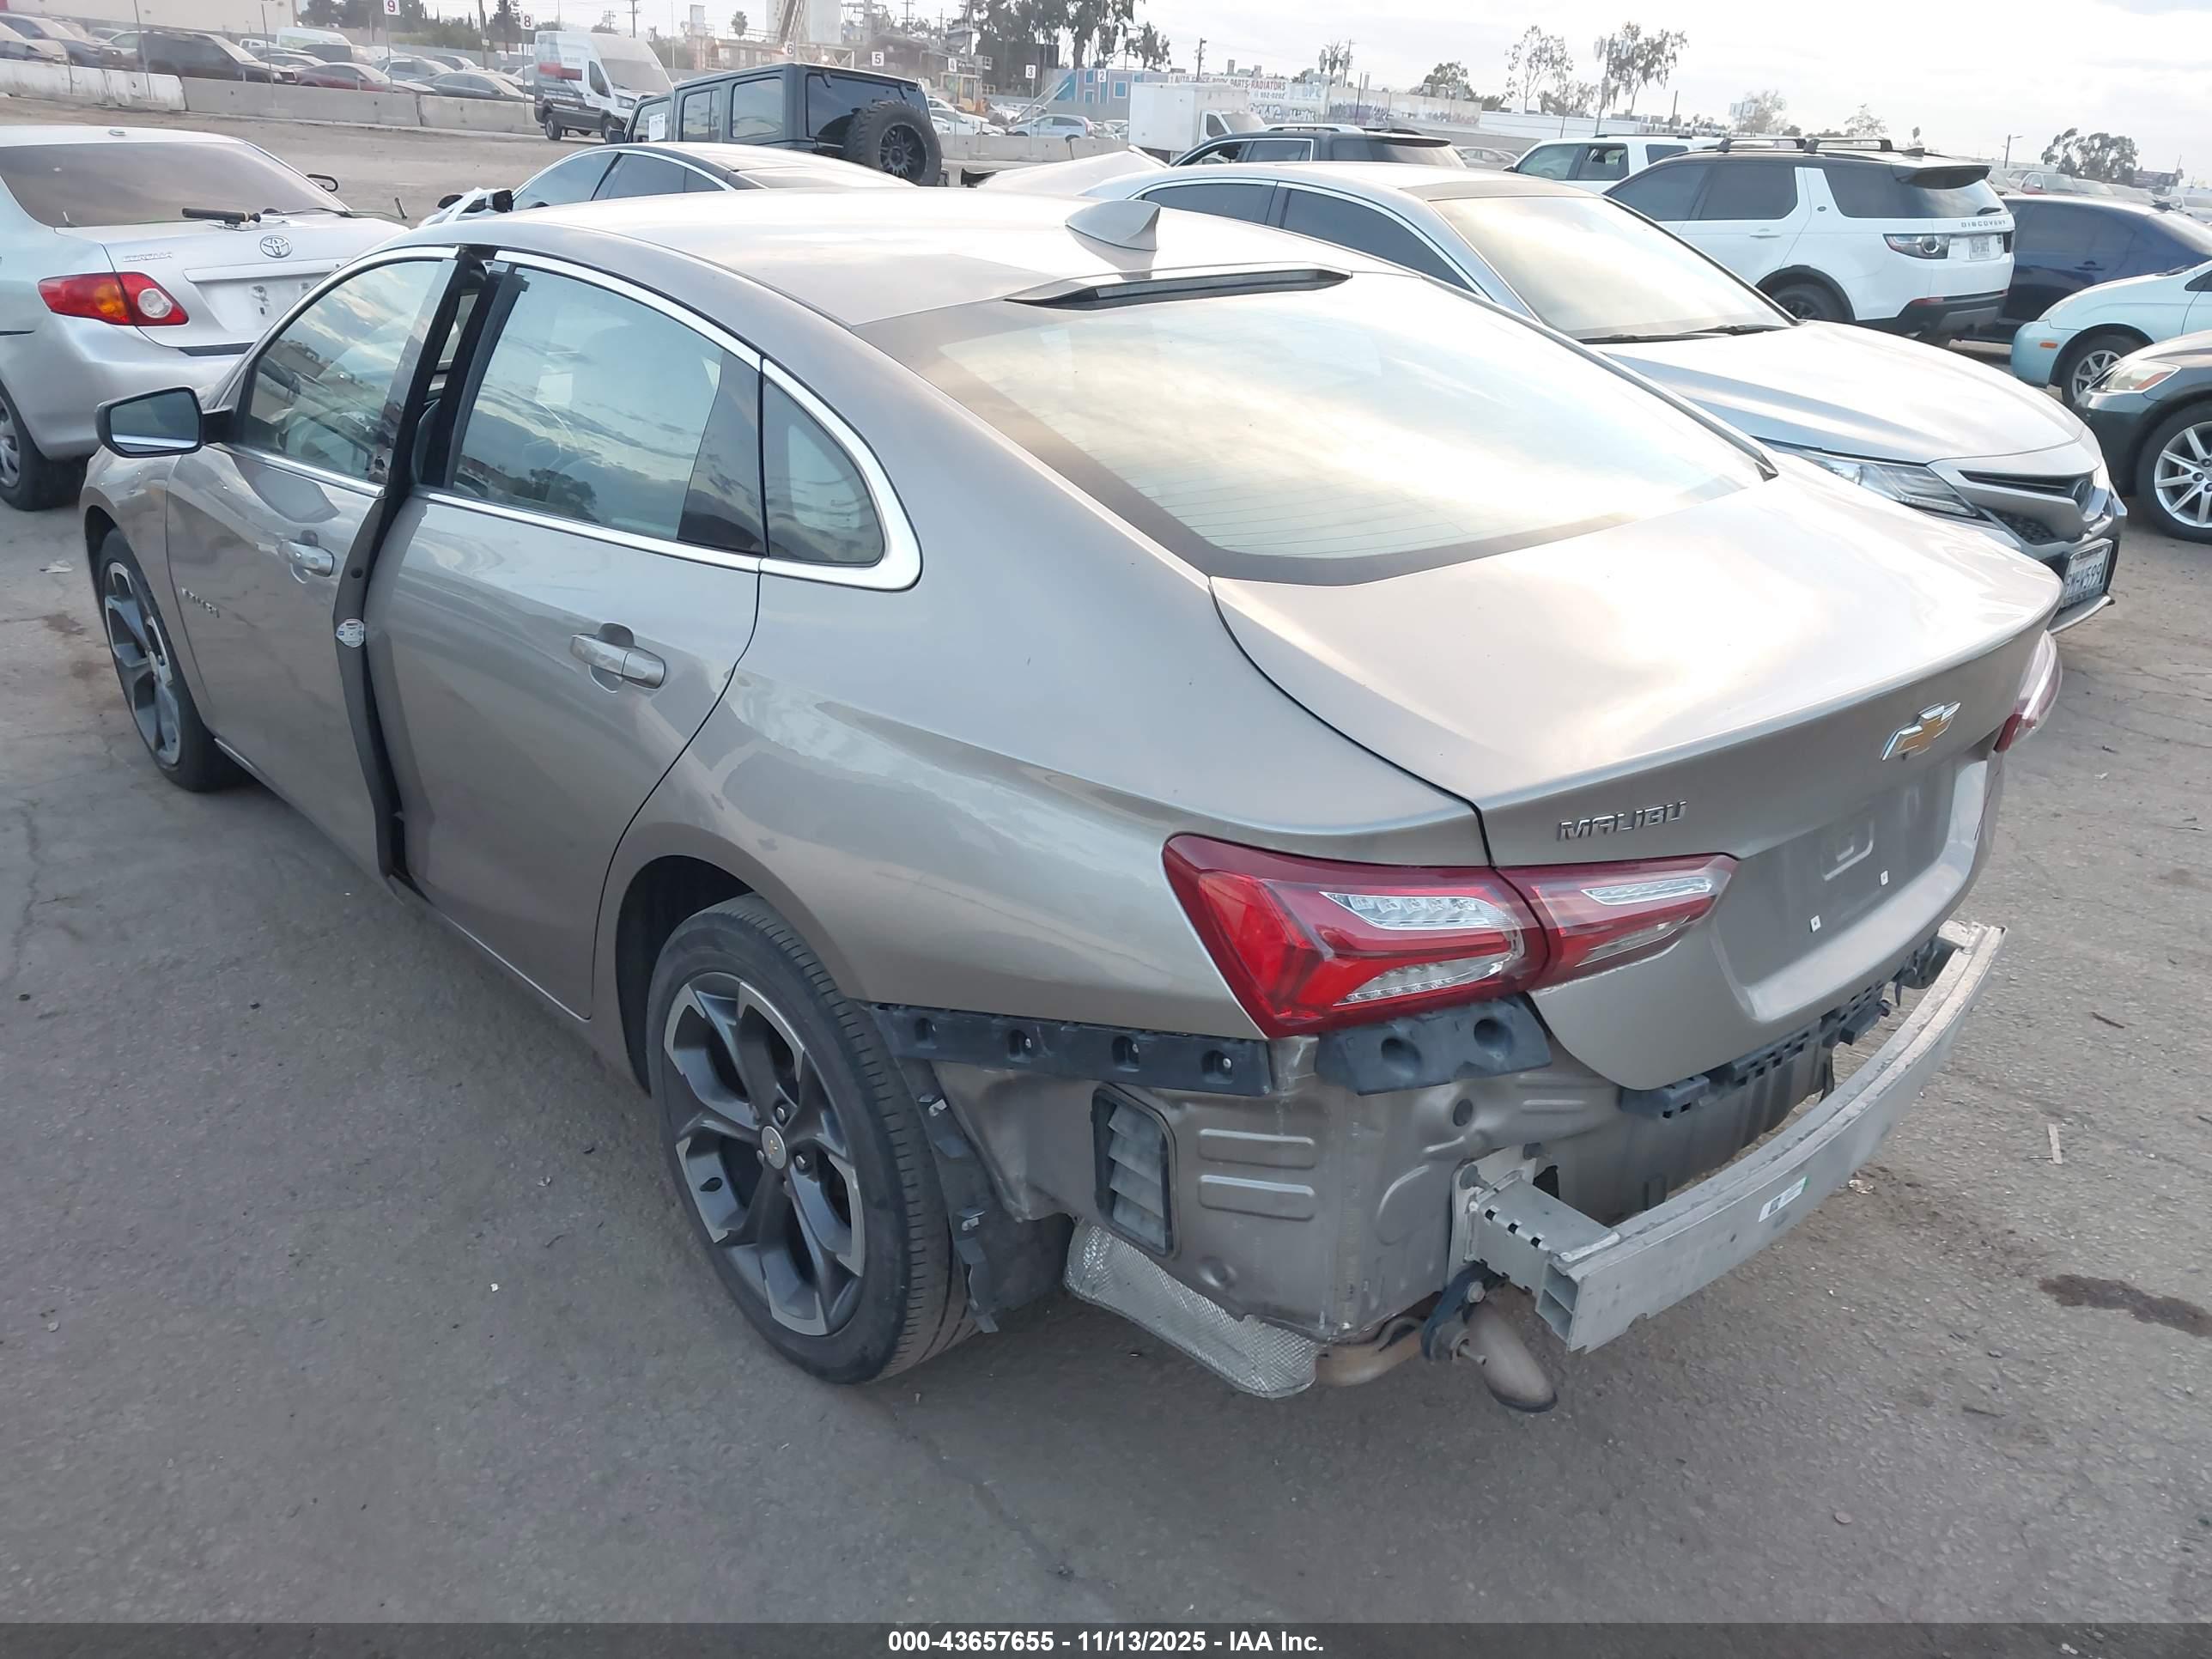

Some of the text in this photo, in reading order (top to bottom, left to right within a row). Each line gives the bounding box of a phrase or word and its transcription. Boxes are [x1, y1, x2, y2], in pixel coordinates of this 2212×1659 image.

[387, 0, 396, 13] 9
[523, 15, 532, 27] 8
[648, 28, 655, 41] 7
[787, 44, 794, 55] 6
[874, 53, 881, 64] 5
[949, 59, 956, 71] 4
[1027, 67, 1034, 77] 3
[1099, 70, 1105, 81] 2
[1556, 799, 1688, 842] MALIBU
